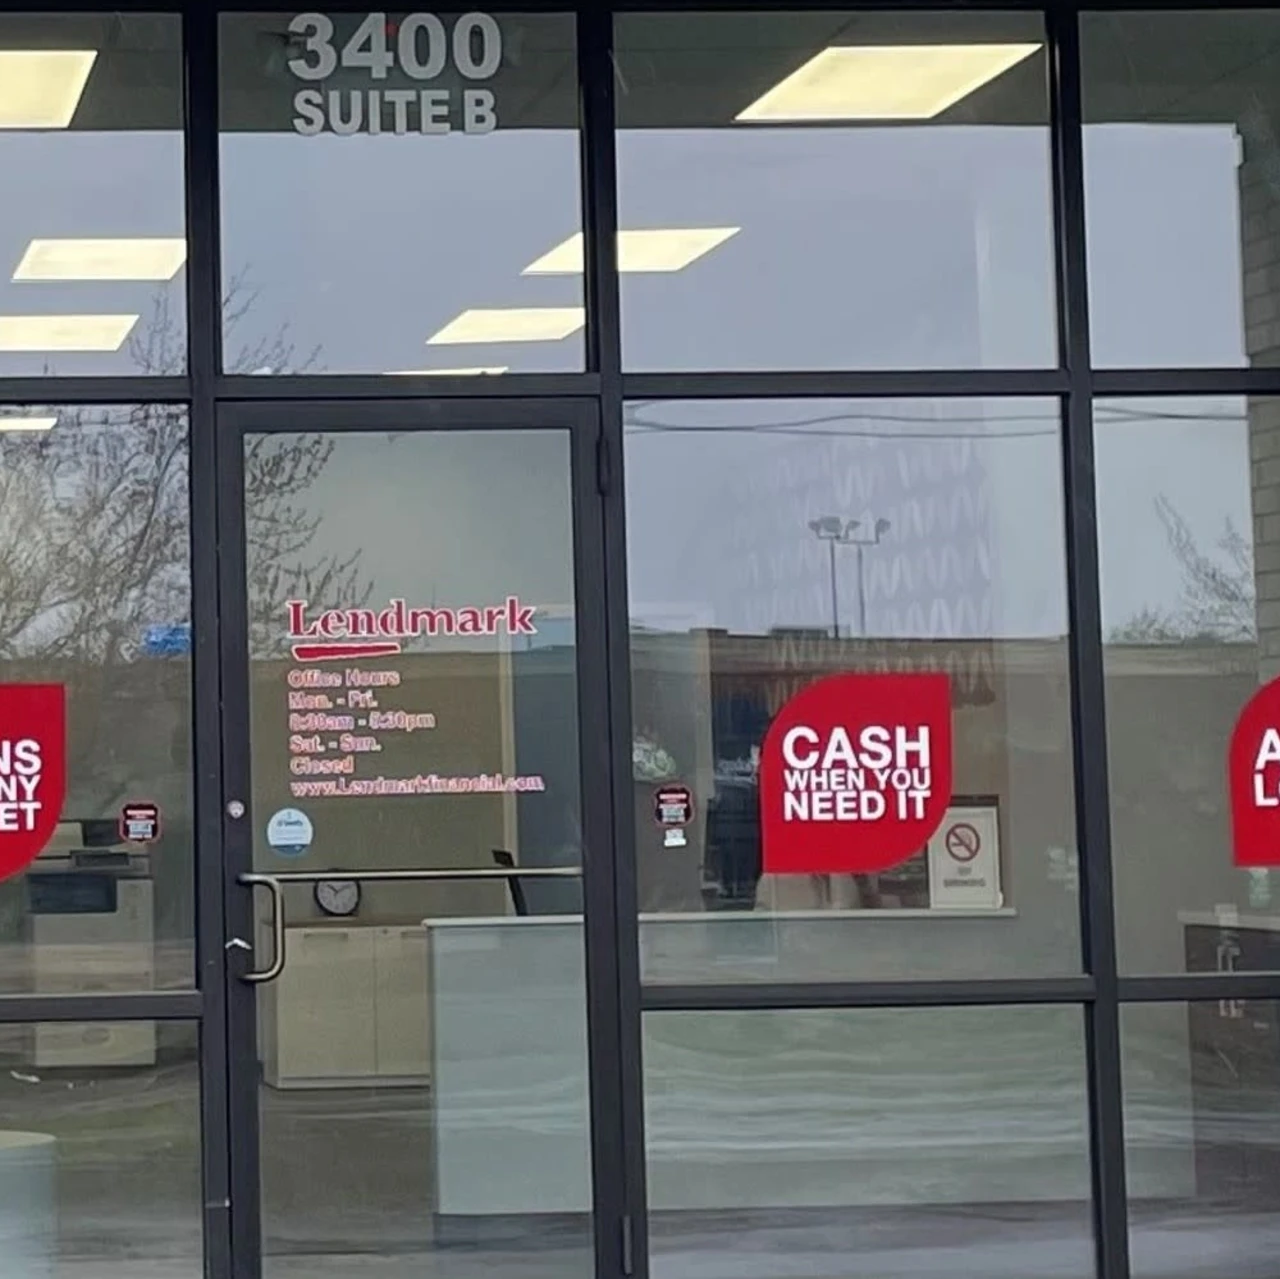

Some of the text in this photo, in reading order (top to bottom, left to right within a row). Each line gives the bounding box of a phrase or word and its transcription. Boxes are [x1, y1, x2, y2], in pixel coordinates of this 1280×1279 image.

[287, 11, 502, 80] 3400
[293, 89, 497, 135] SUITE B
[286, 596, 538, 638] Lendmark
[287, 668, 401, 688] Office Hours
[290, 754, 354, 775] Closed
[782, 725, 931, 770] CASH
[783, 767, 932, 791] WHEN YOU
[783, 790, 931, 821] NEED IT
